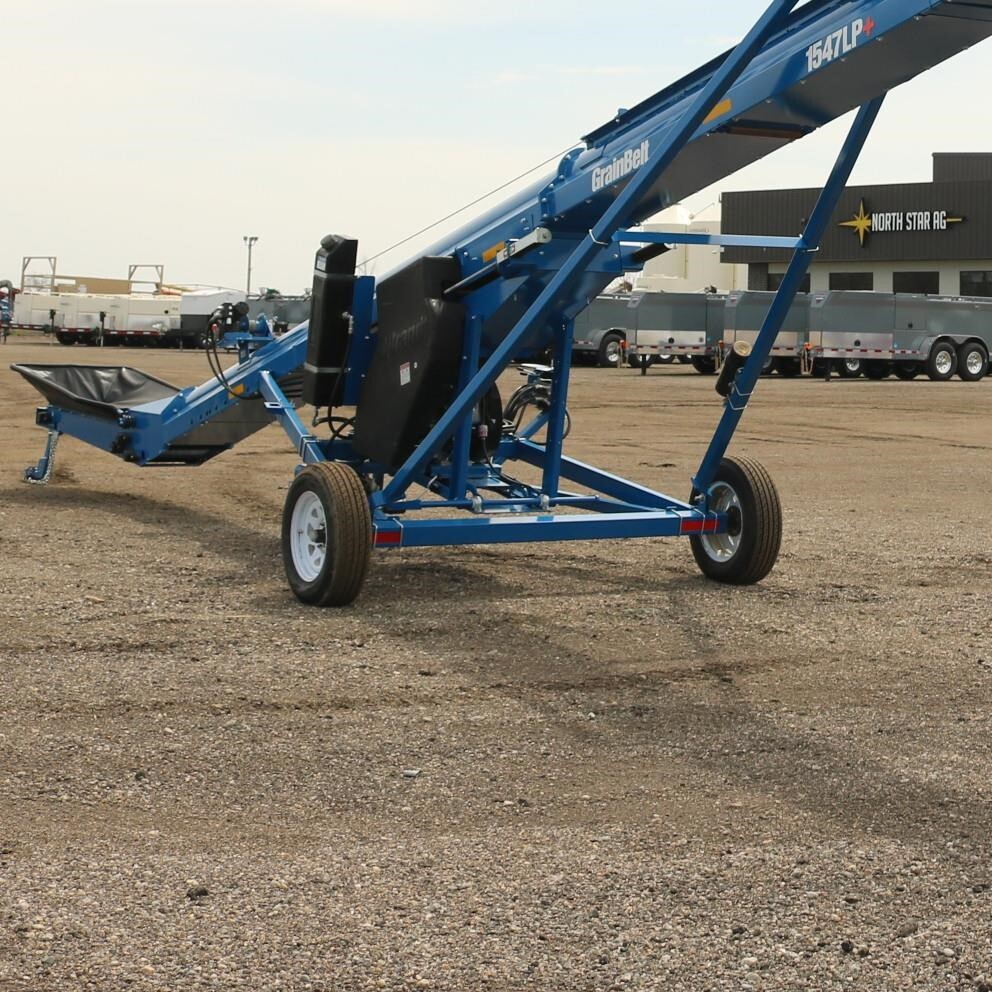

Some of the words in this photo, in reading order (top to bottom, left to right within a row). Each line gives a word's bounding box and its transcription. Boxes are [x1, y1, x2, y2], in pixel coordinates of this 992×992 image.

[805, 16, 876, 73] 1547LP+
[591, 139, 649, 192] GrainBelt
[871, 212, 903, 232] NORTH
[905, 211, 931, 231] STAR
[933, 210, 947, 230] AG
